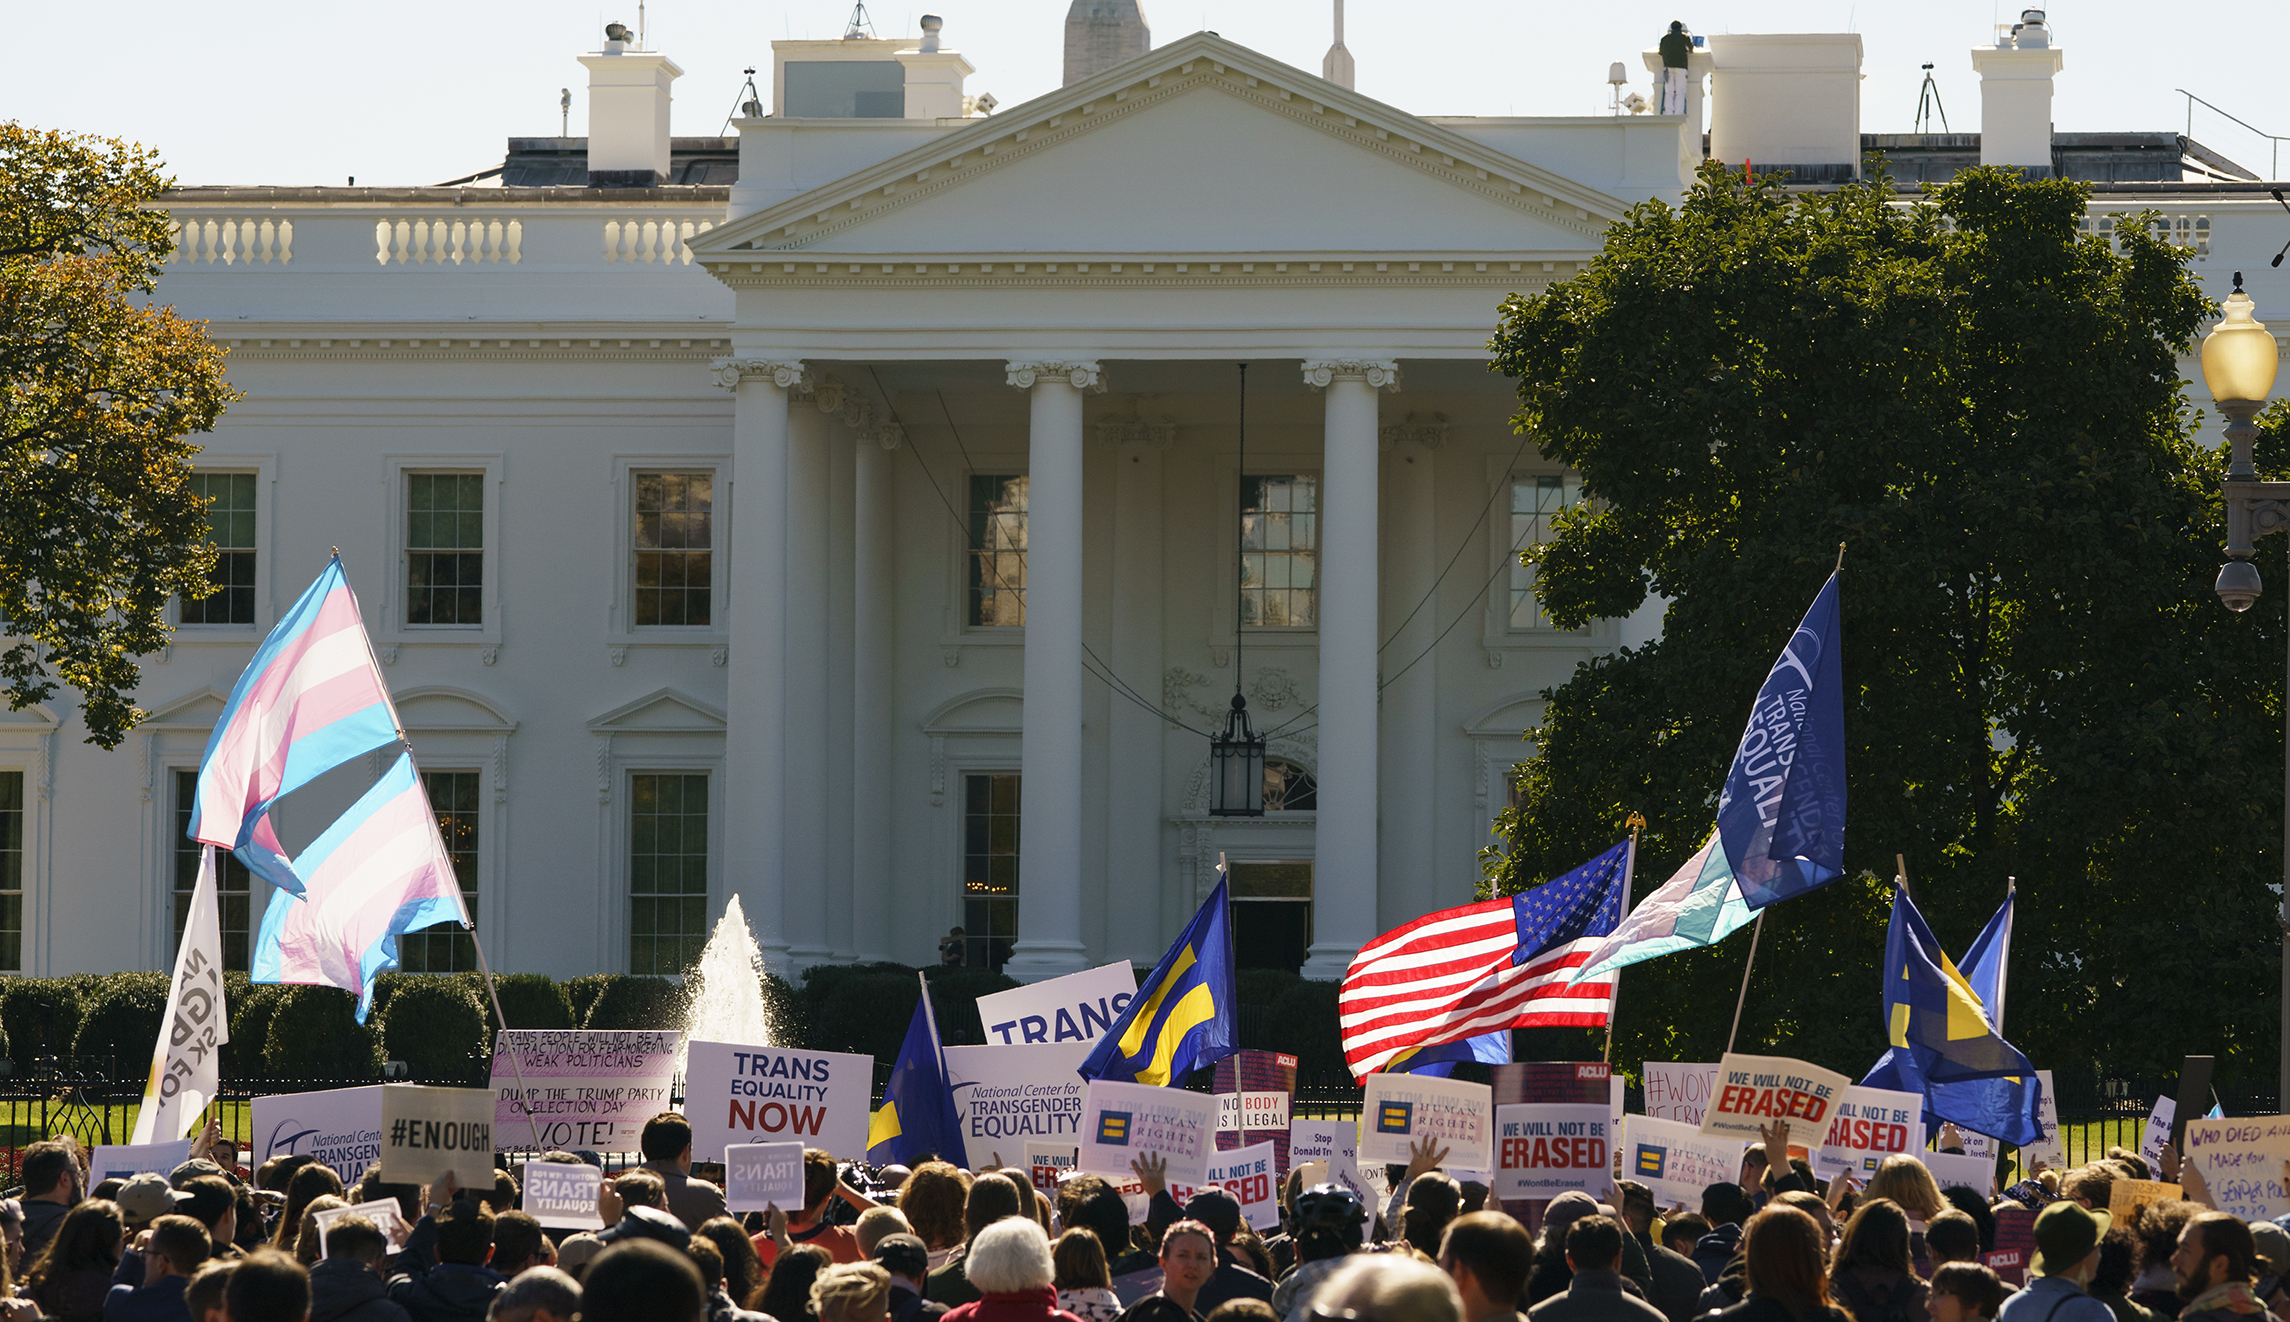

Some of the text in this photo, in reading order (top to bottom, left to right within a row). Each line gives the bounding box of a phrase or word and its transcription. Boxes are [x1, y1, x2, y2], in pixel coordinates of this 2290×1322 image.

[541, 1032, 582, 1043] PEOPLE
[587, 1032, 610, 1043] WILL
[613, 1032, 631, 1044] NOT
[637, 1032, 653, 1044] BE
[655, 1032, 664, 1044] A
[578, 1043, 596, 1054] FOR
[524, 1054, 644, 1068] WEAK POLITICIANS
[733, 1052, 830, 1082] TRANS
[1277, 1055, 1296, 1067] ACLU
[1577, 1066, 1607, 1078] ACLU
[731, 1079, 828, 1102] EQUALITY
[971, 1082, 1080, 1098] National Center for
[1728, 1071, 1834, 1099] WE WILL NOT BE
[545, 1088, 570, 1100] THE
[576, 1088, 624, 1101] TRUMP
[628, 1088, 665, 1101] PARTY
[532, 1102, 597, 1114] ELECTION
[602, 1101, 627, 1114] DAY
[969, 1097, 1082, 1115] TRANSGENDER
[1223, 1097, 1279, 1111] NO BODY
[1420, 1103, 1477, 1117] HUMAN
[1717, 1085, 1828, 1123] ERASED
[728, 1099, 827, 1136] NOW
[1139, 1112, 1198, 1130] HUMAN
[1861, 1105, 1889, 1121] NOT
[1892, 1109, 1909, 1123] BE
[2152, 1115, 2166, 1128] The
[971, 1113, 1082, 1139] EQUALITY
[1418, 1116, 1475, 1130] RIGHTS
[1503, 1122, 1604, 1137] WE WILL NOT BE
[312, 1131, 356, 1148] National
[390, 1118, 490, 1152] #ENOUGH
[1137, 1126, 1195, 1144] RIGHTS
[1314, 1133, 1332, 1144] Stop
[1417, 1130, 1474, 1141] CAMPAIGN
[1823, 1117, 1907, 1153] RASED
[2190, 1127, 2221, 1148] WHO
[2226, 1126, 2261, 1143] DIED
[1134, 1141, 1192, 1156] CAMPAIGN
[1293, 1146, 1321, 1156] Donald
[1500, 1137, 1606, 1169] ERASED
[1032, 1154, 1049, 1166] WE
[1673, 1148, 1726, 1168] HUMAN
[2209, 1151, 2265, 1170] MADE YOU
[1208, 1168, 1225, 1180] ILL
[1229, 1163, 1251, 1179] NOT
[1254, 1159, 1267, 1173] BE
[1671, 1162, 1723, 1181] RIGHTS
[1518, 1179, 1585, 1188] #WontBeErased
[1989, 1252, 2019, 1268] ACLU
